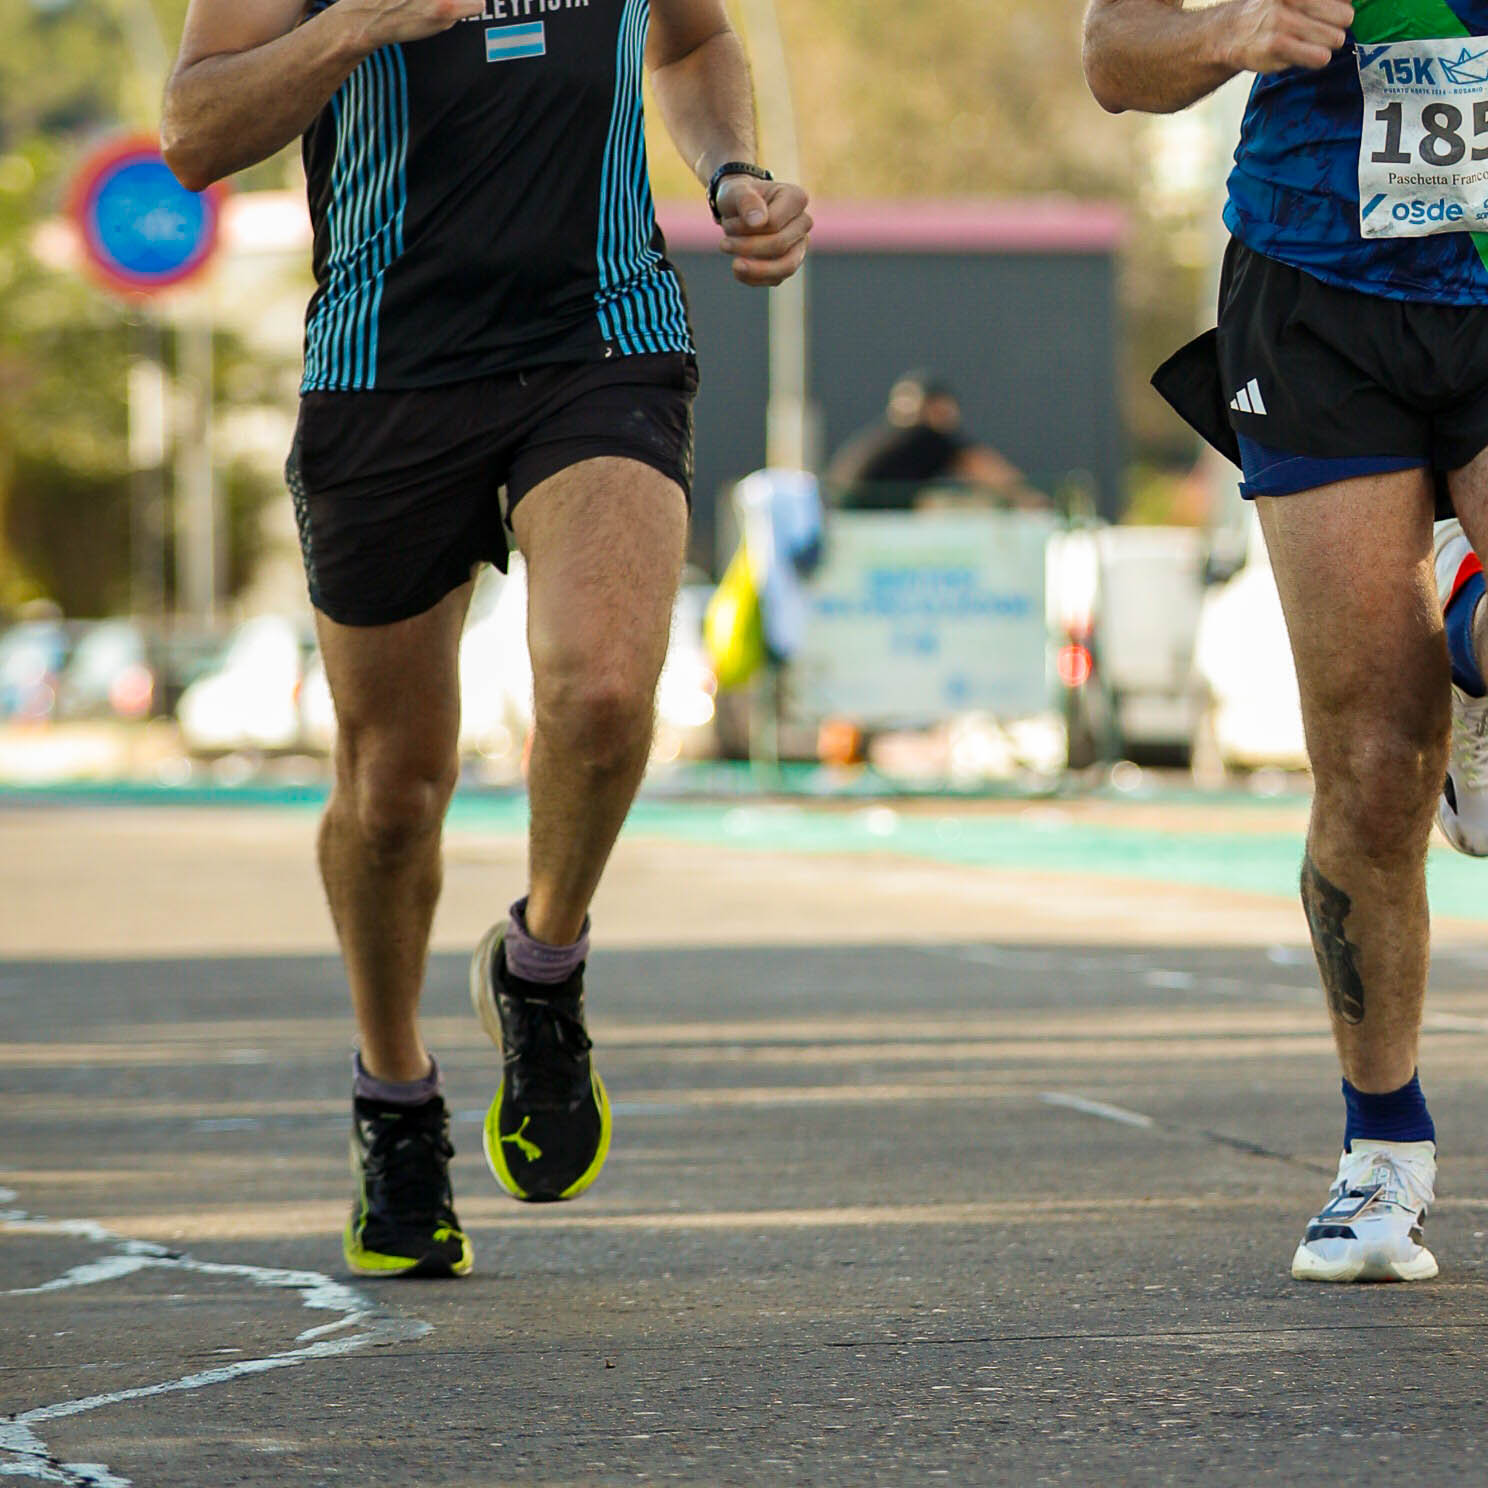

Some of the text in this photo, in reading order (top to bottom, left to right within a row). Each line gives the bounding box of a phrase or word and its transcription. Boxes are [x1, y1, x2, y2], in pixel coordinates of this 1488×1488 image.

[1379, 57, 1436, 85] 15K
[1453, 86, 1484, 95] ROSARIO
[1388, 172, 1448, 185] Paschetta
[1392, 197, 1464, 223] osde
